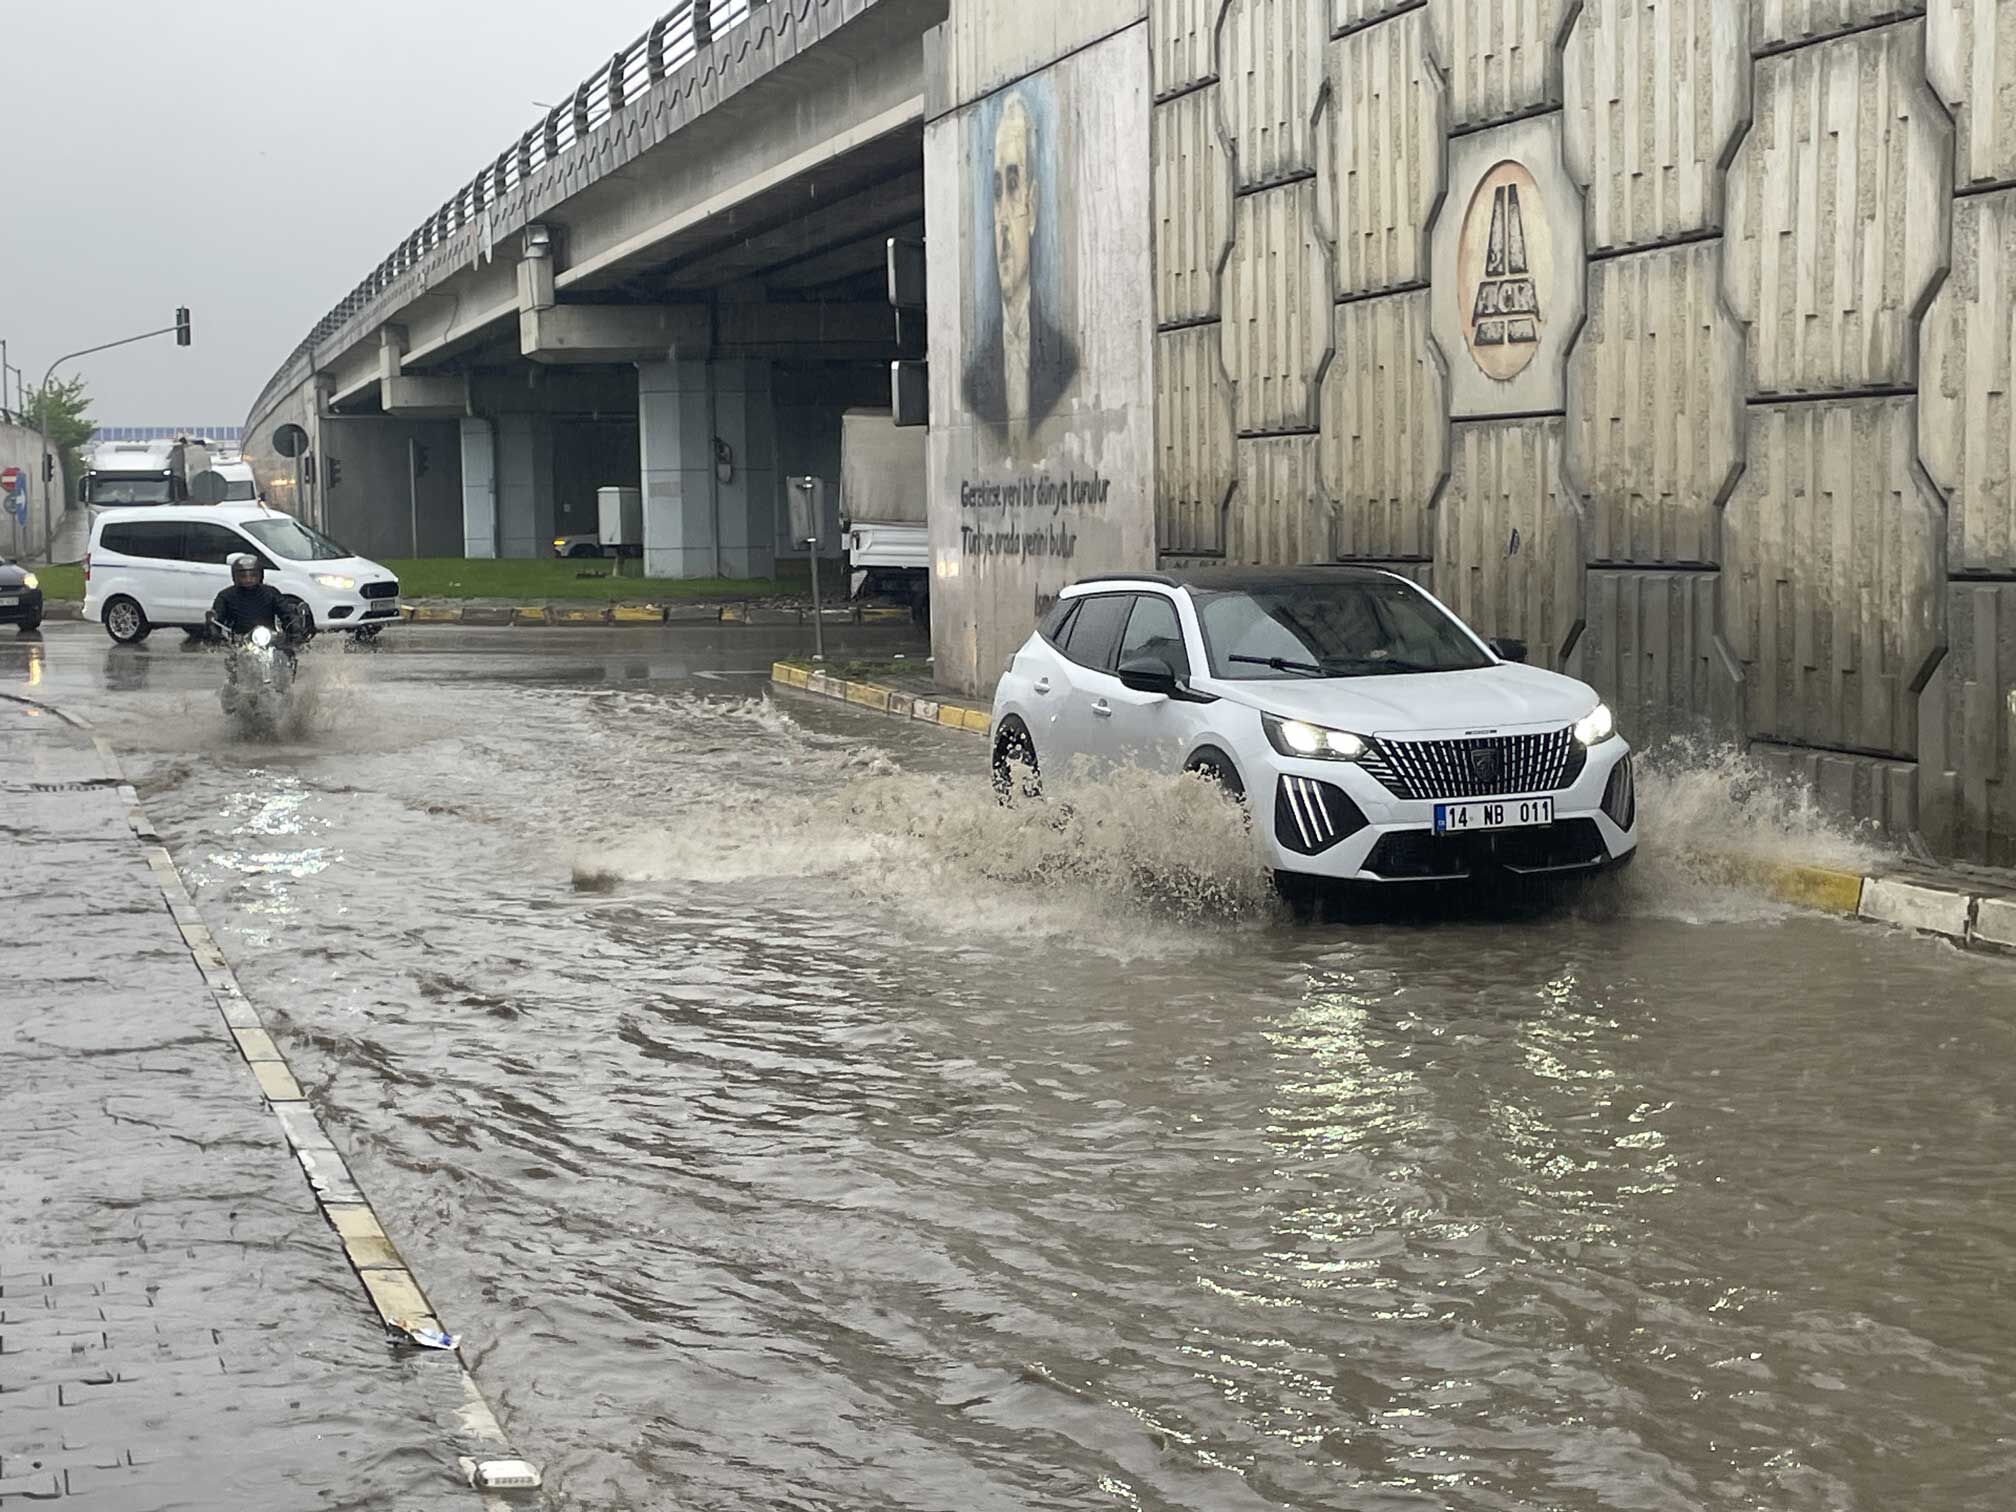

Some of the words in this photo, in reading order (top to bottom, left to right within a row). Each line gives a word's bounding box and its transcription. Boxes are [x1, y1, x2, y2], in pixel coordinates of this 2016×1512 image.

[1070, 470, 1110, 505] kurulur
[1049, 520, 1077, 559] bulur
[1449, 807, 1468, 828] 14
[1483, 804, 1504, 825] NB
[1520, 800, 1549, 823] 011
